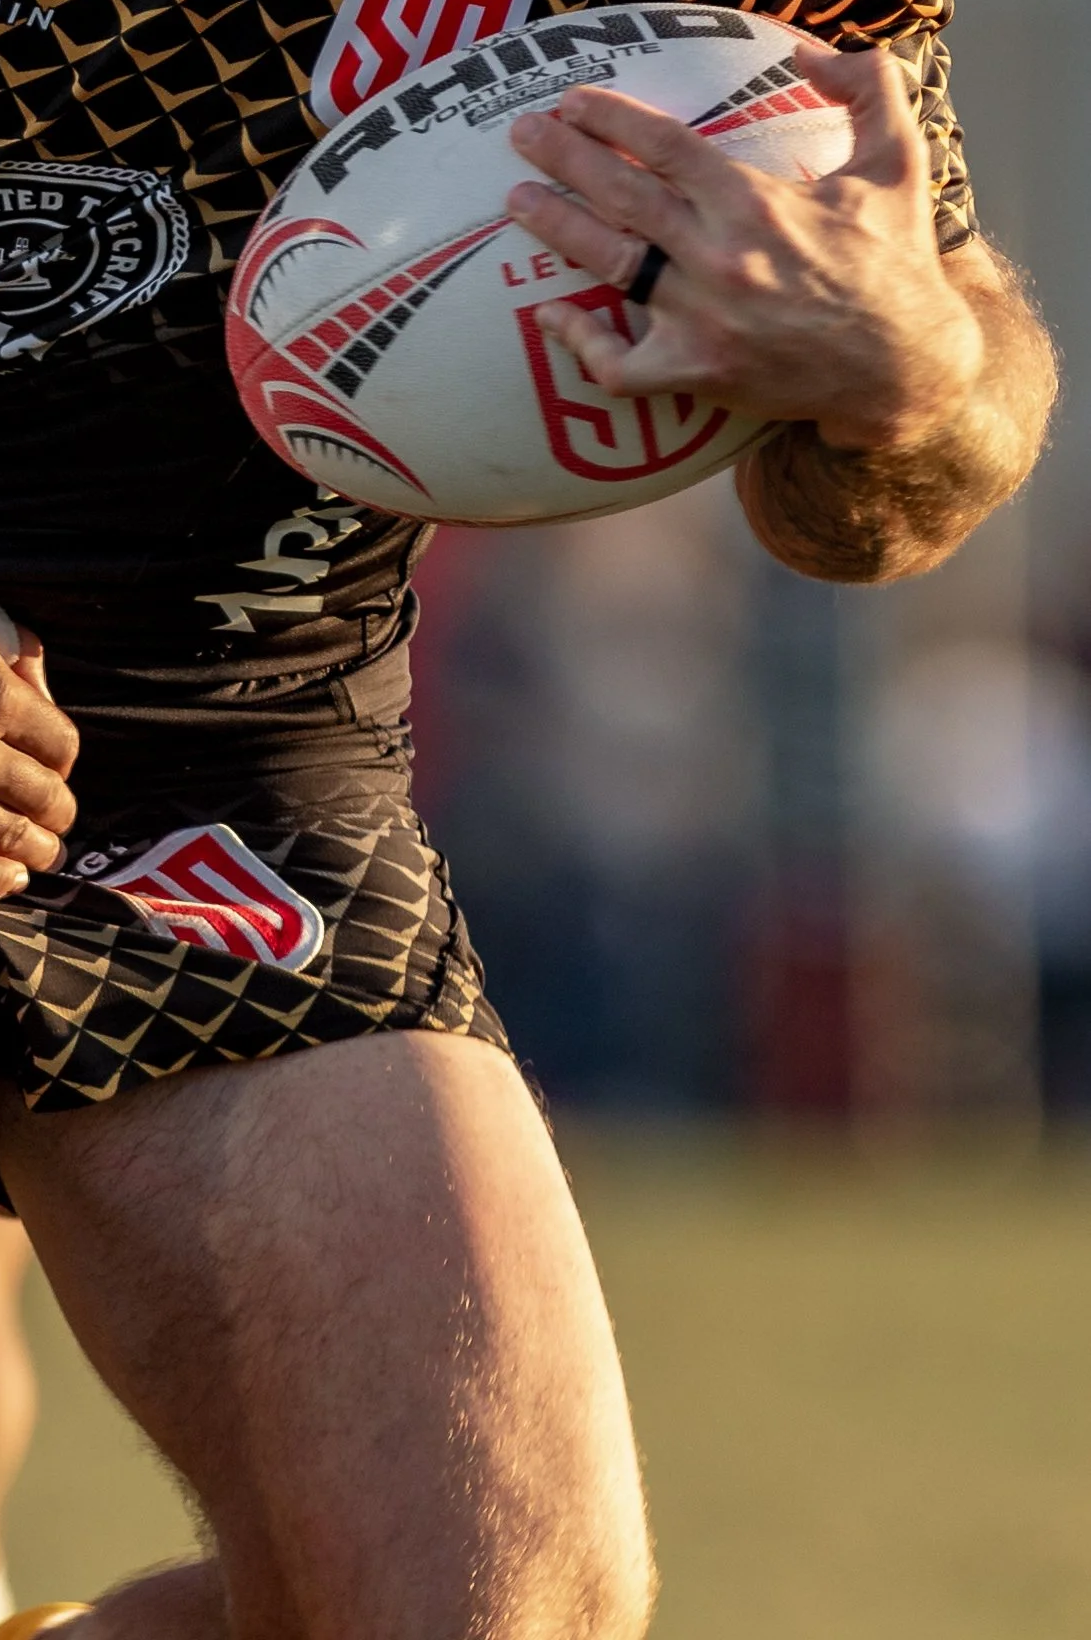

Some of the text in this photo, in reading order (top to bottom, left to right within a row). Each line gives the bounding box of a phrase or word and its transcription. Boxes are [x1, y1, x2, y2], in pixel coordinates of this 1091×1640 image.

[309, 6, 756, 194] RHINO
[410, 65, 551, 134] VORTEX
[565, 42, 663, 69] ELITE
